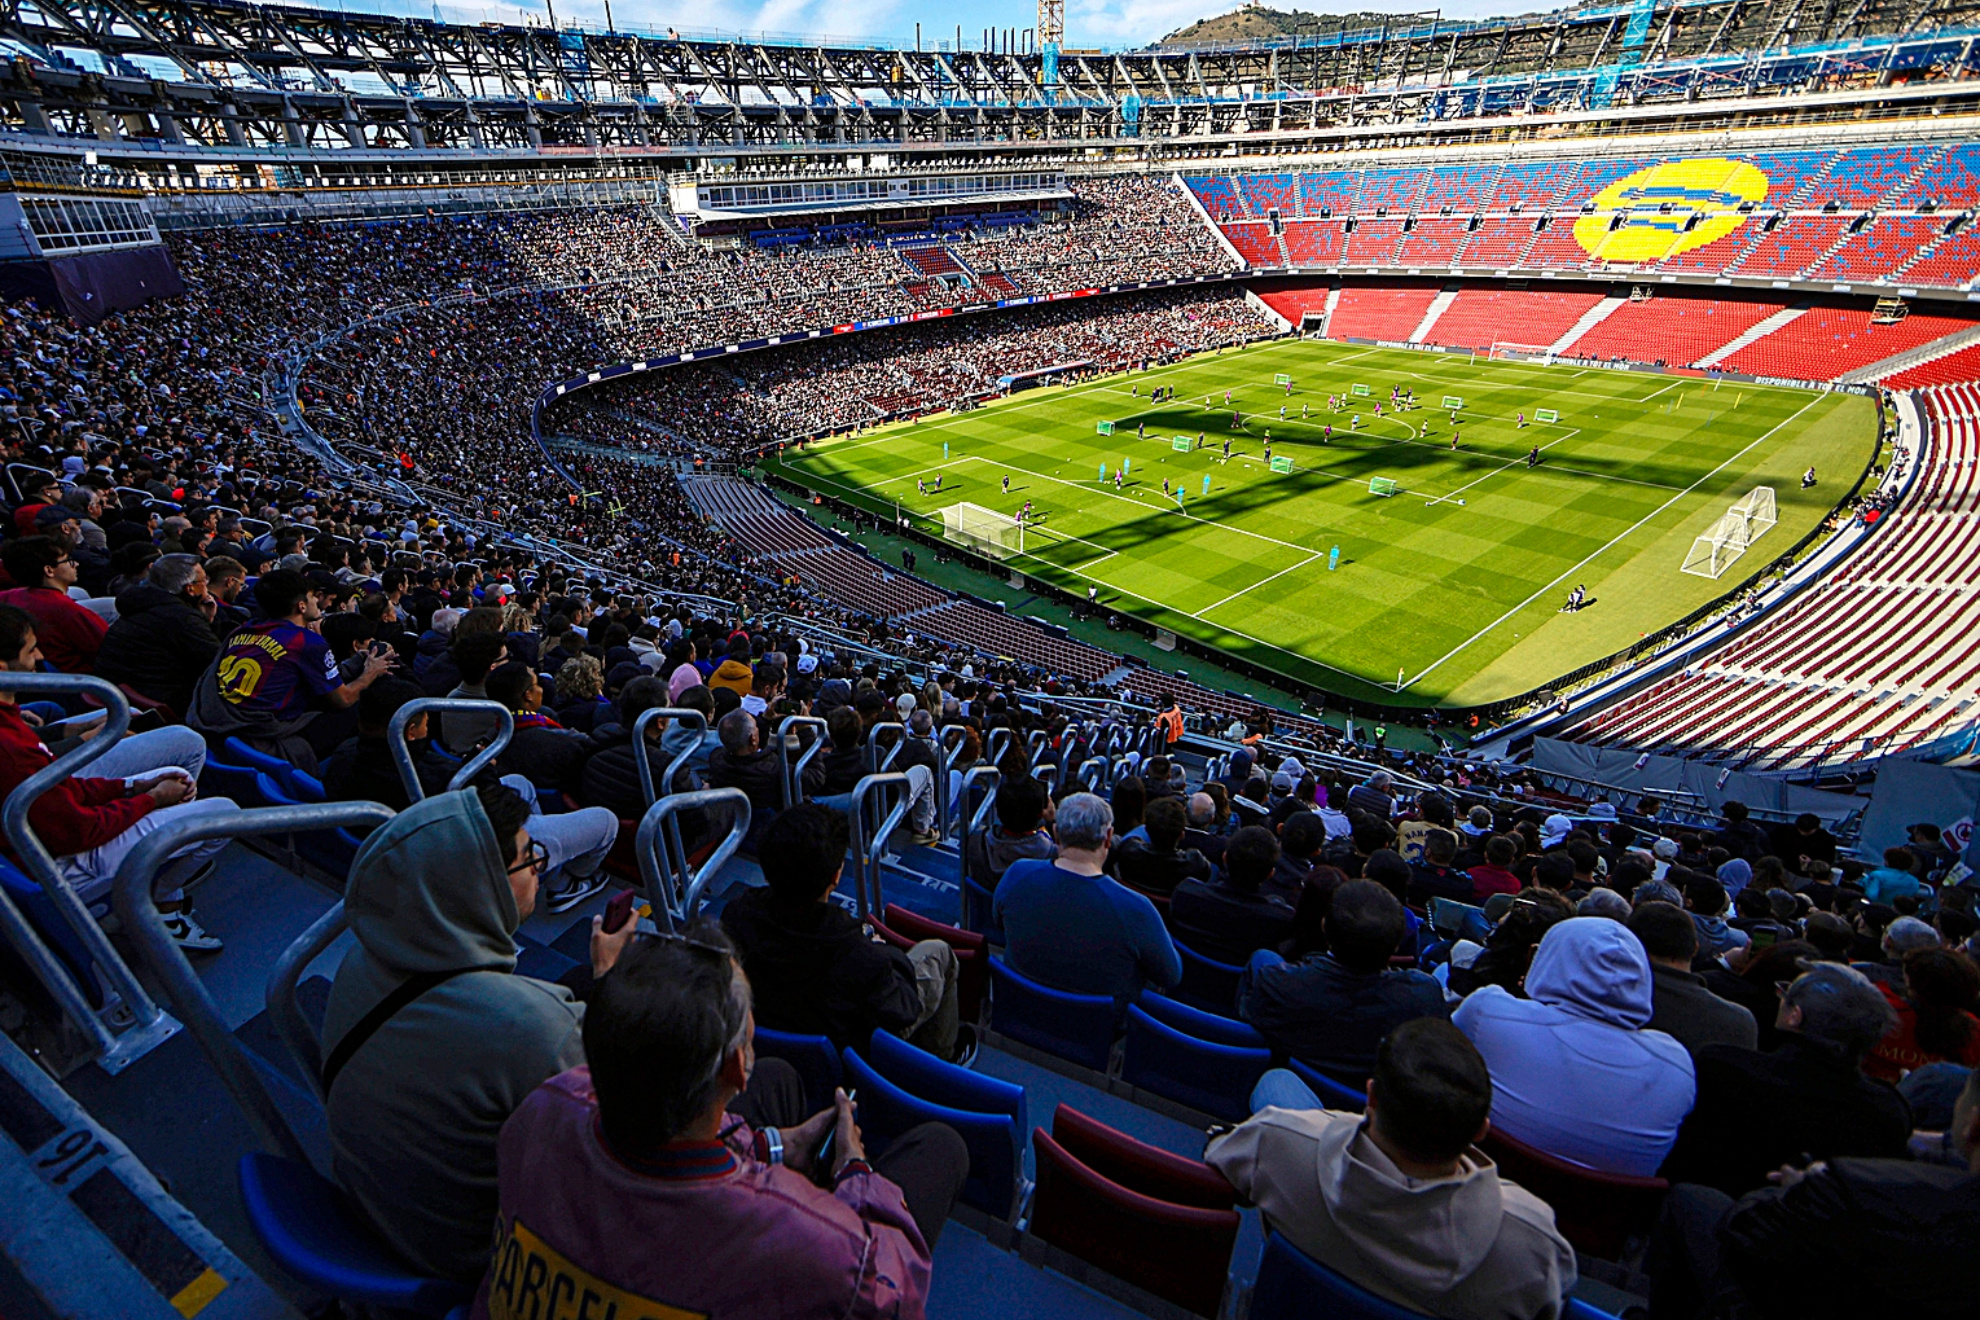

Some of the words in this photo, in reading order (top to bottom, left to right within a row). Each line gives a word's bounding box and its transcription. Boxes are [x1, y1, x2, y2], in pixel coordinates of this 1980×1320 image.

[1755, 376, 1806, 389] DISPONIBLE
[1806, 380, 1815, 389] A
[1834, 383, 1845, 393] EL
[255, 634, 288, 661] YAMAL
